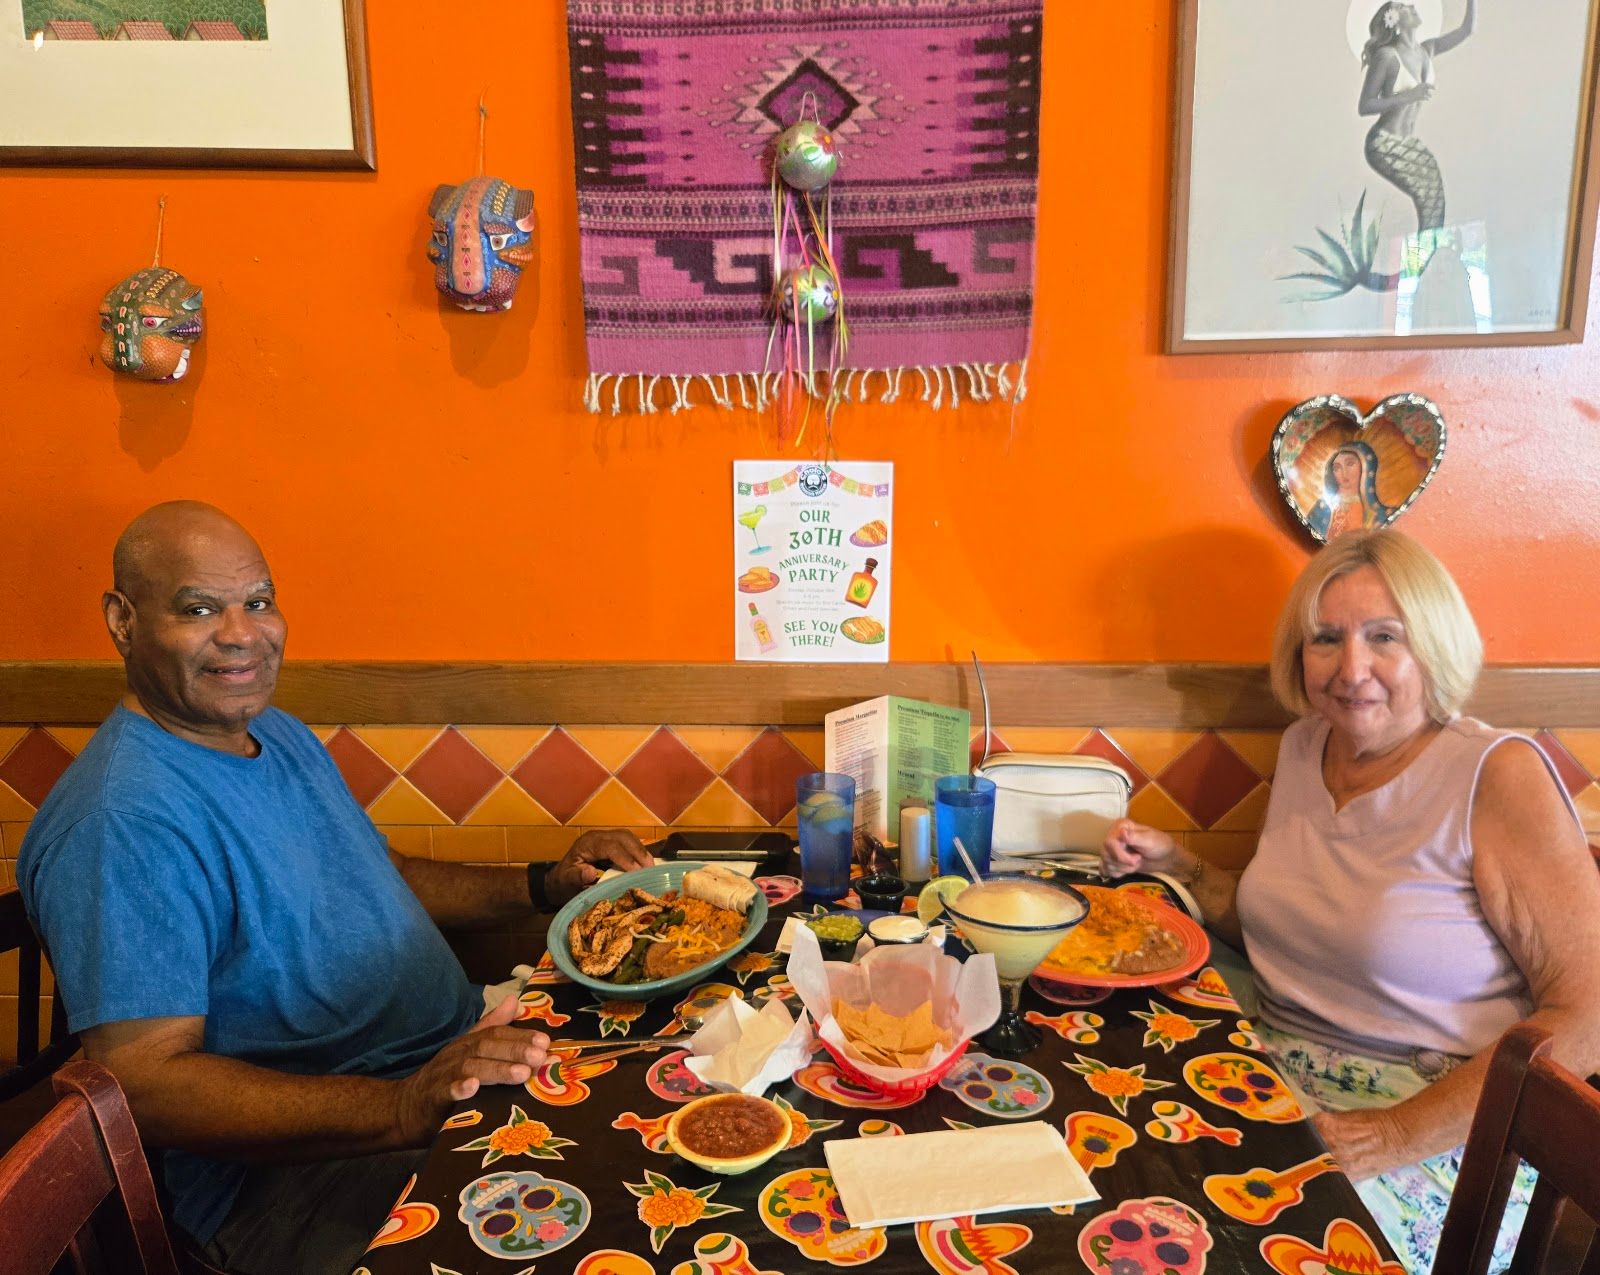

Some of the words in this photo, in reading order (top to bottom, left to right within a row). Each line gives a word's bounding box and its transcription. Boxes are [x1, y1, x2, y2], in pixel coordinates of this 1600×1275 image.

[799, 510, 831, 524] OUR
[789, 527, 842, 550] 30TH
[778, 553, 850, 571] ANNIVERSARY
[788, 568, 839, 583] PARTY
[784, 620, 805, 634] SEE
[811, 620, 838, 634] YOU
[789, 634, 836, 648] THERE!
